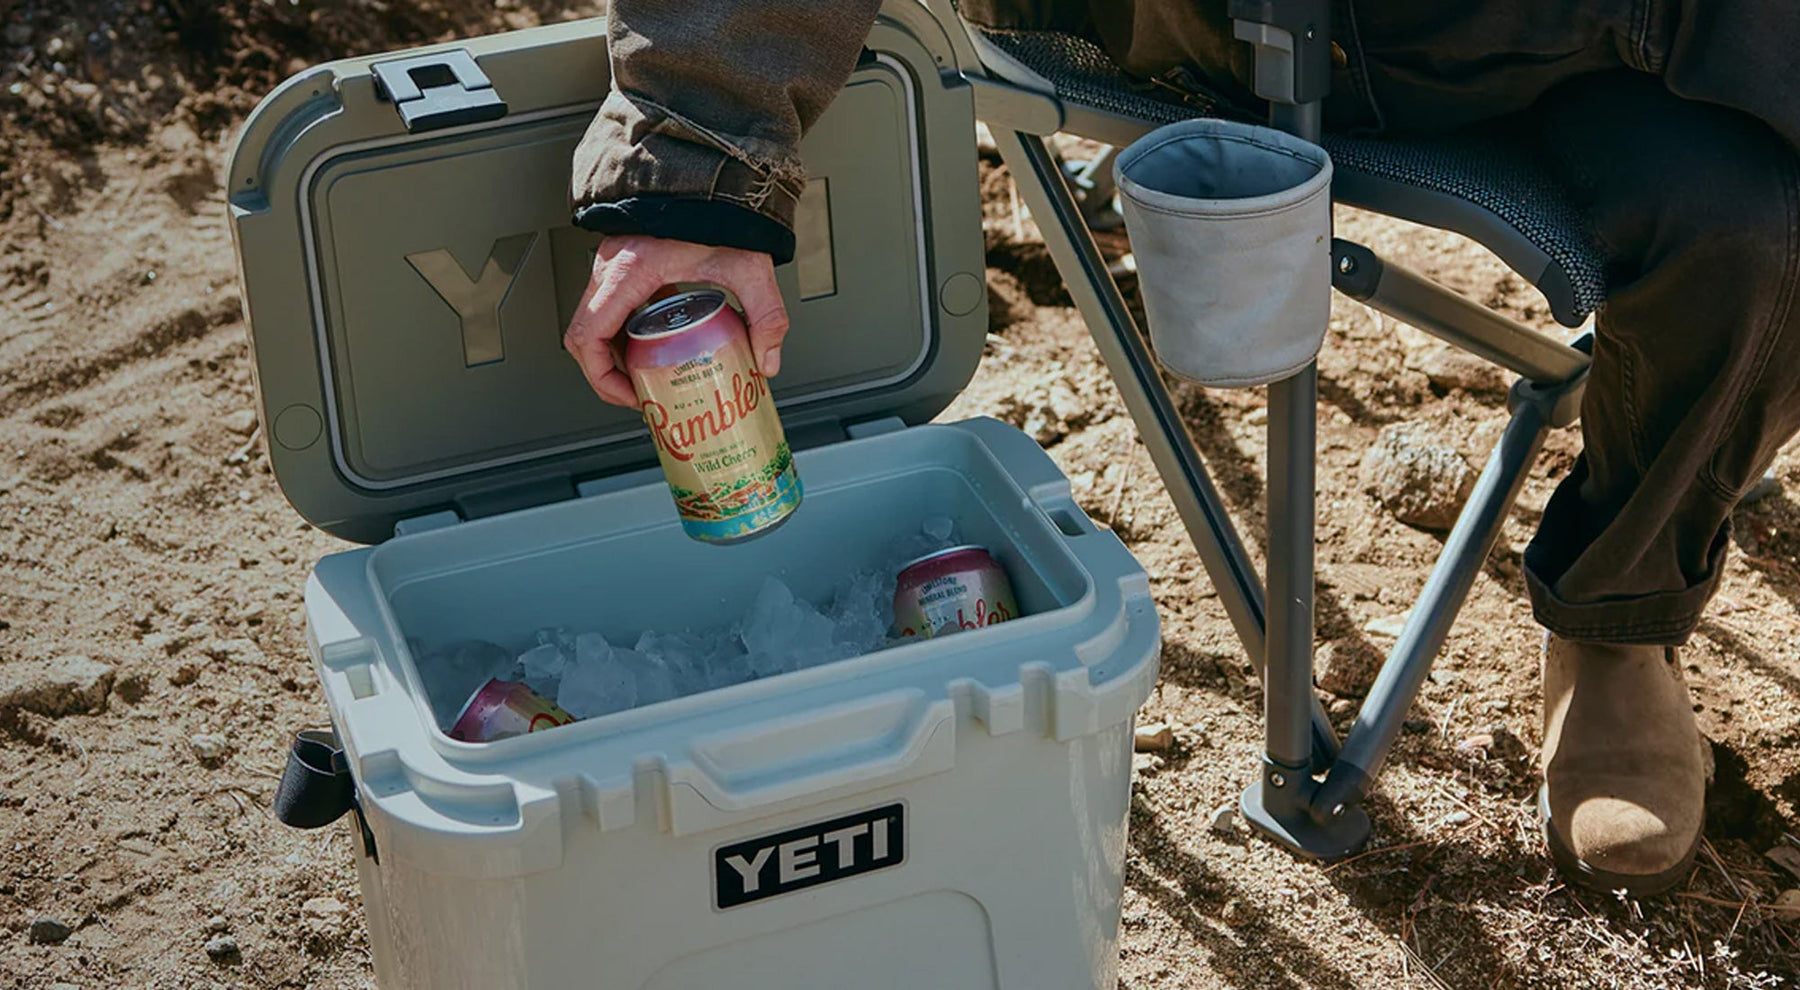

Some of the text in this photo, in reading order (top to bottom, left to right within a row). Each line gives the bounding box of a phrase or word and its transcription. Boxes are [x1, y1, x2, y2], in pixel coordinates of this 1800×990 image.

[642, 368, 766, 461] Rambler
[694, 459, 721, 473] Wild
[721, 445, 757, 468] Cherry
[724, 818, 888, 893] YETI
